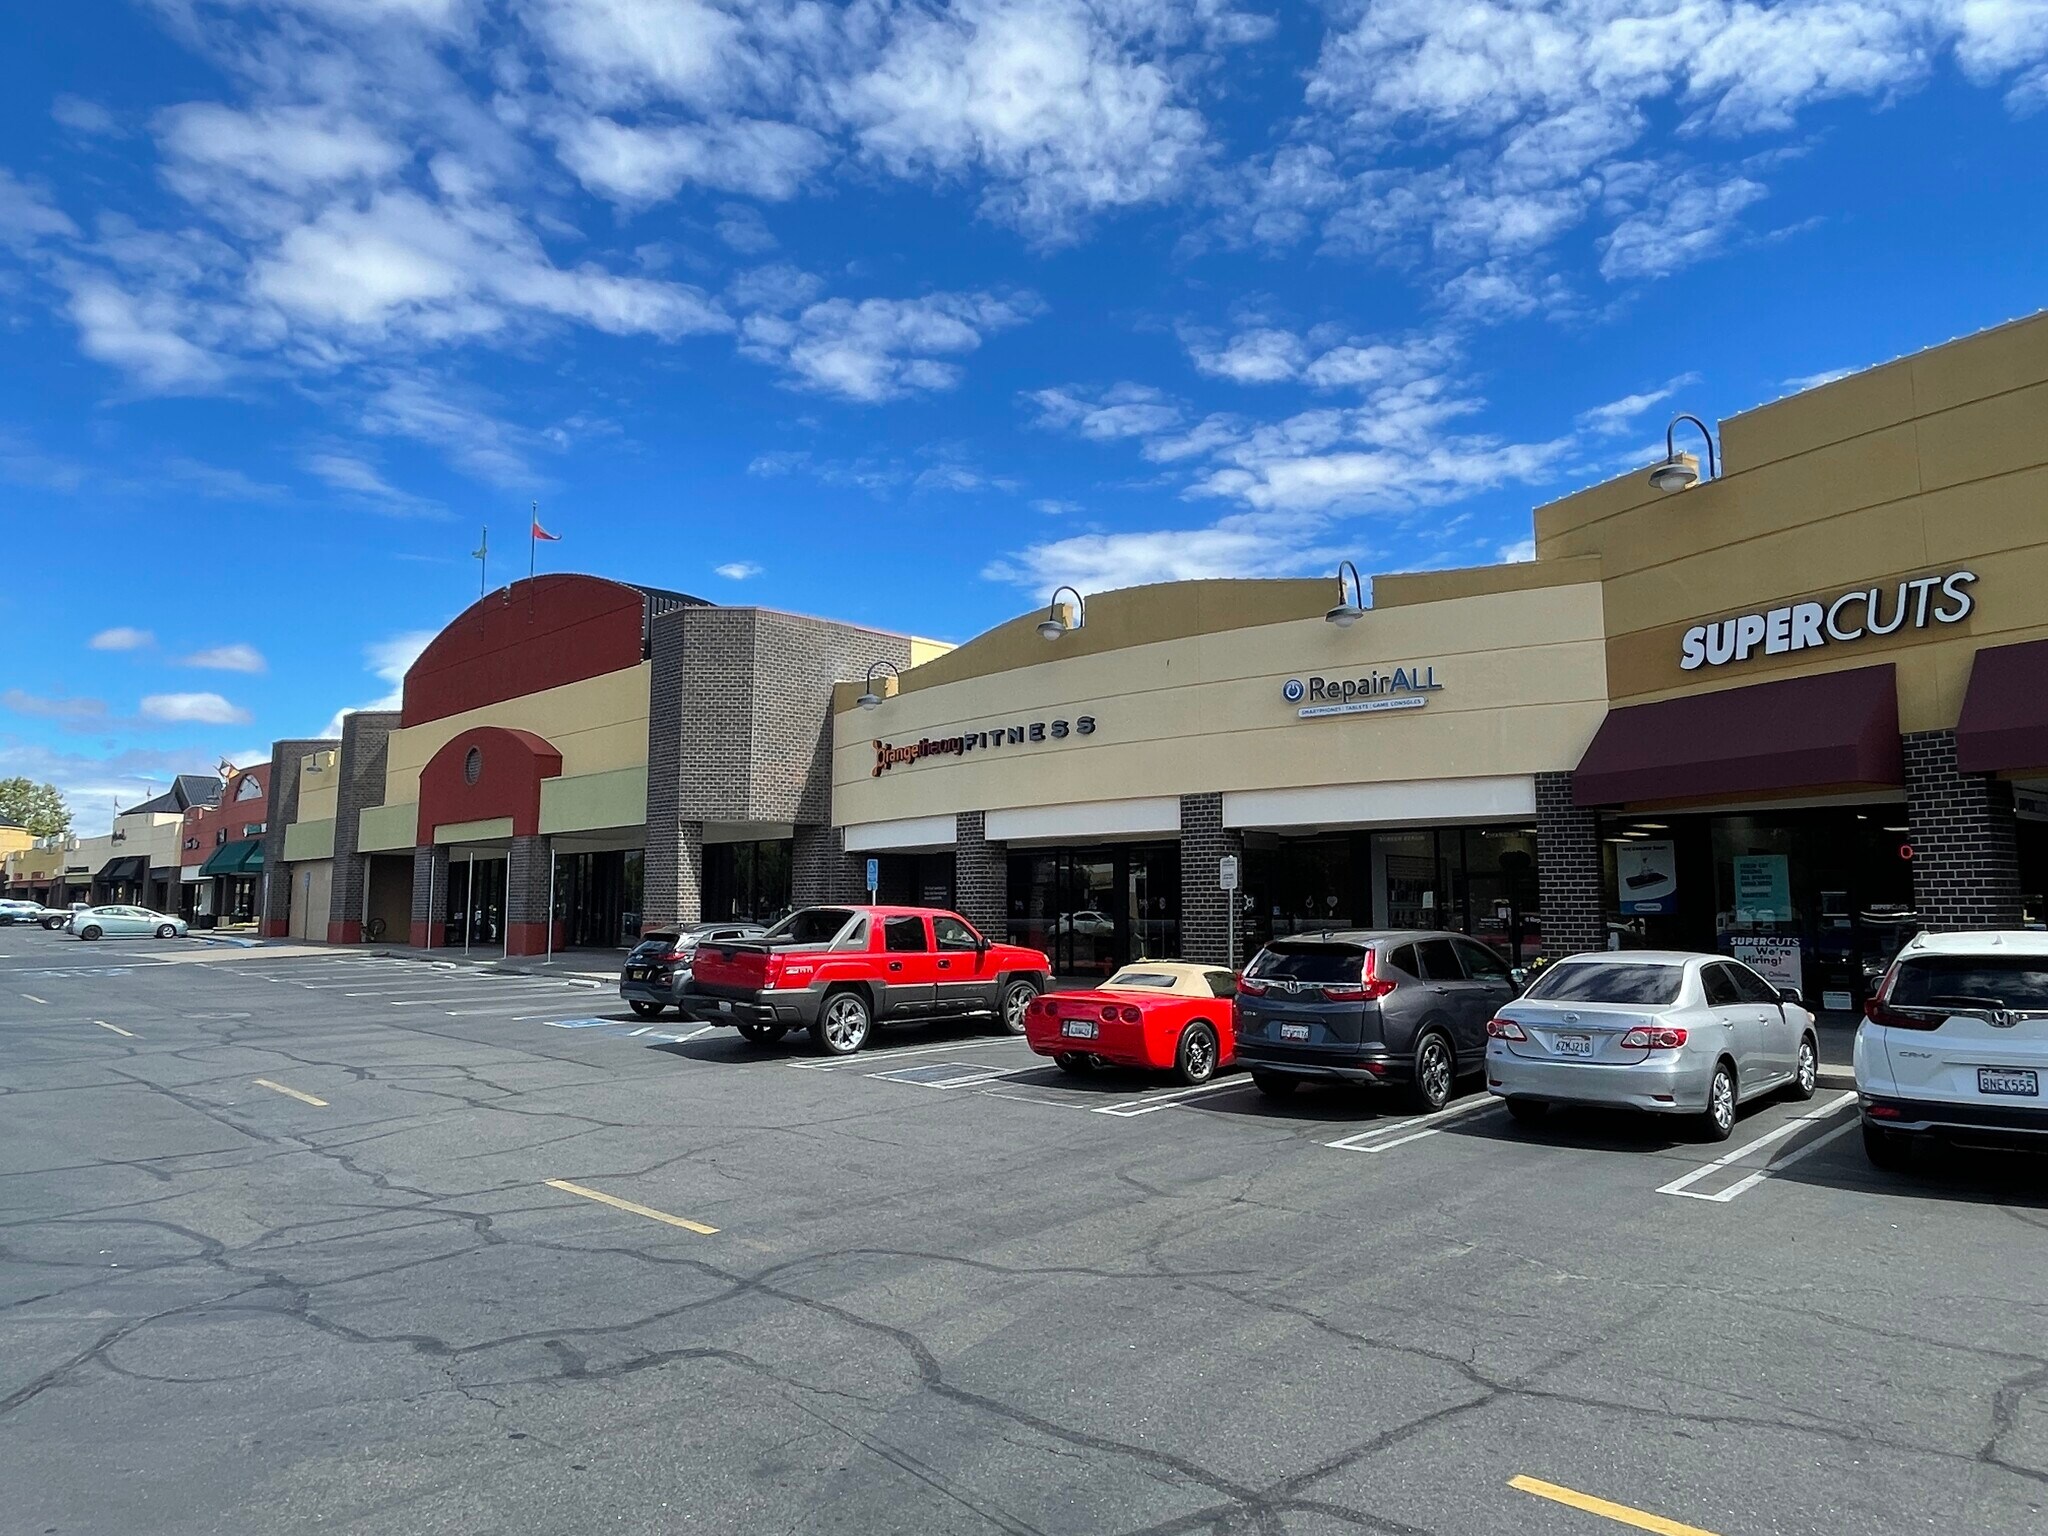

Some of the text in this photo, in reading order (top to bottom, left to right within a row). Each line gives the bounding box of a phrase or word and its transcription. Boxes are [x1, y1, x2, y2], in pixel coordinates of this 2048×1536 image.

[1679, 570, 1977, 670] SUPERCUTS
[1308, 666, 1444, 704] RepairALL
[1345, 703, 1369, 712] TABLETS
[1372, 701, 1390, 710] GAME
[1390, 698, 1422, 708] CONSOLES
[963, 715, 1096, 752] FITNESS
[1729, 936, 1801, 946] SUPERCUTS
[1756, 947, 1792, 957] We're
[1743, 955, 1783, 967] Hiring!
[1898, 1051, 1933, 1060] CR-V
[1981, 1076, 2035, 1094] 8NEK555
